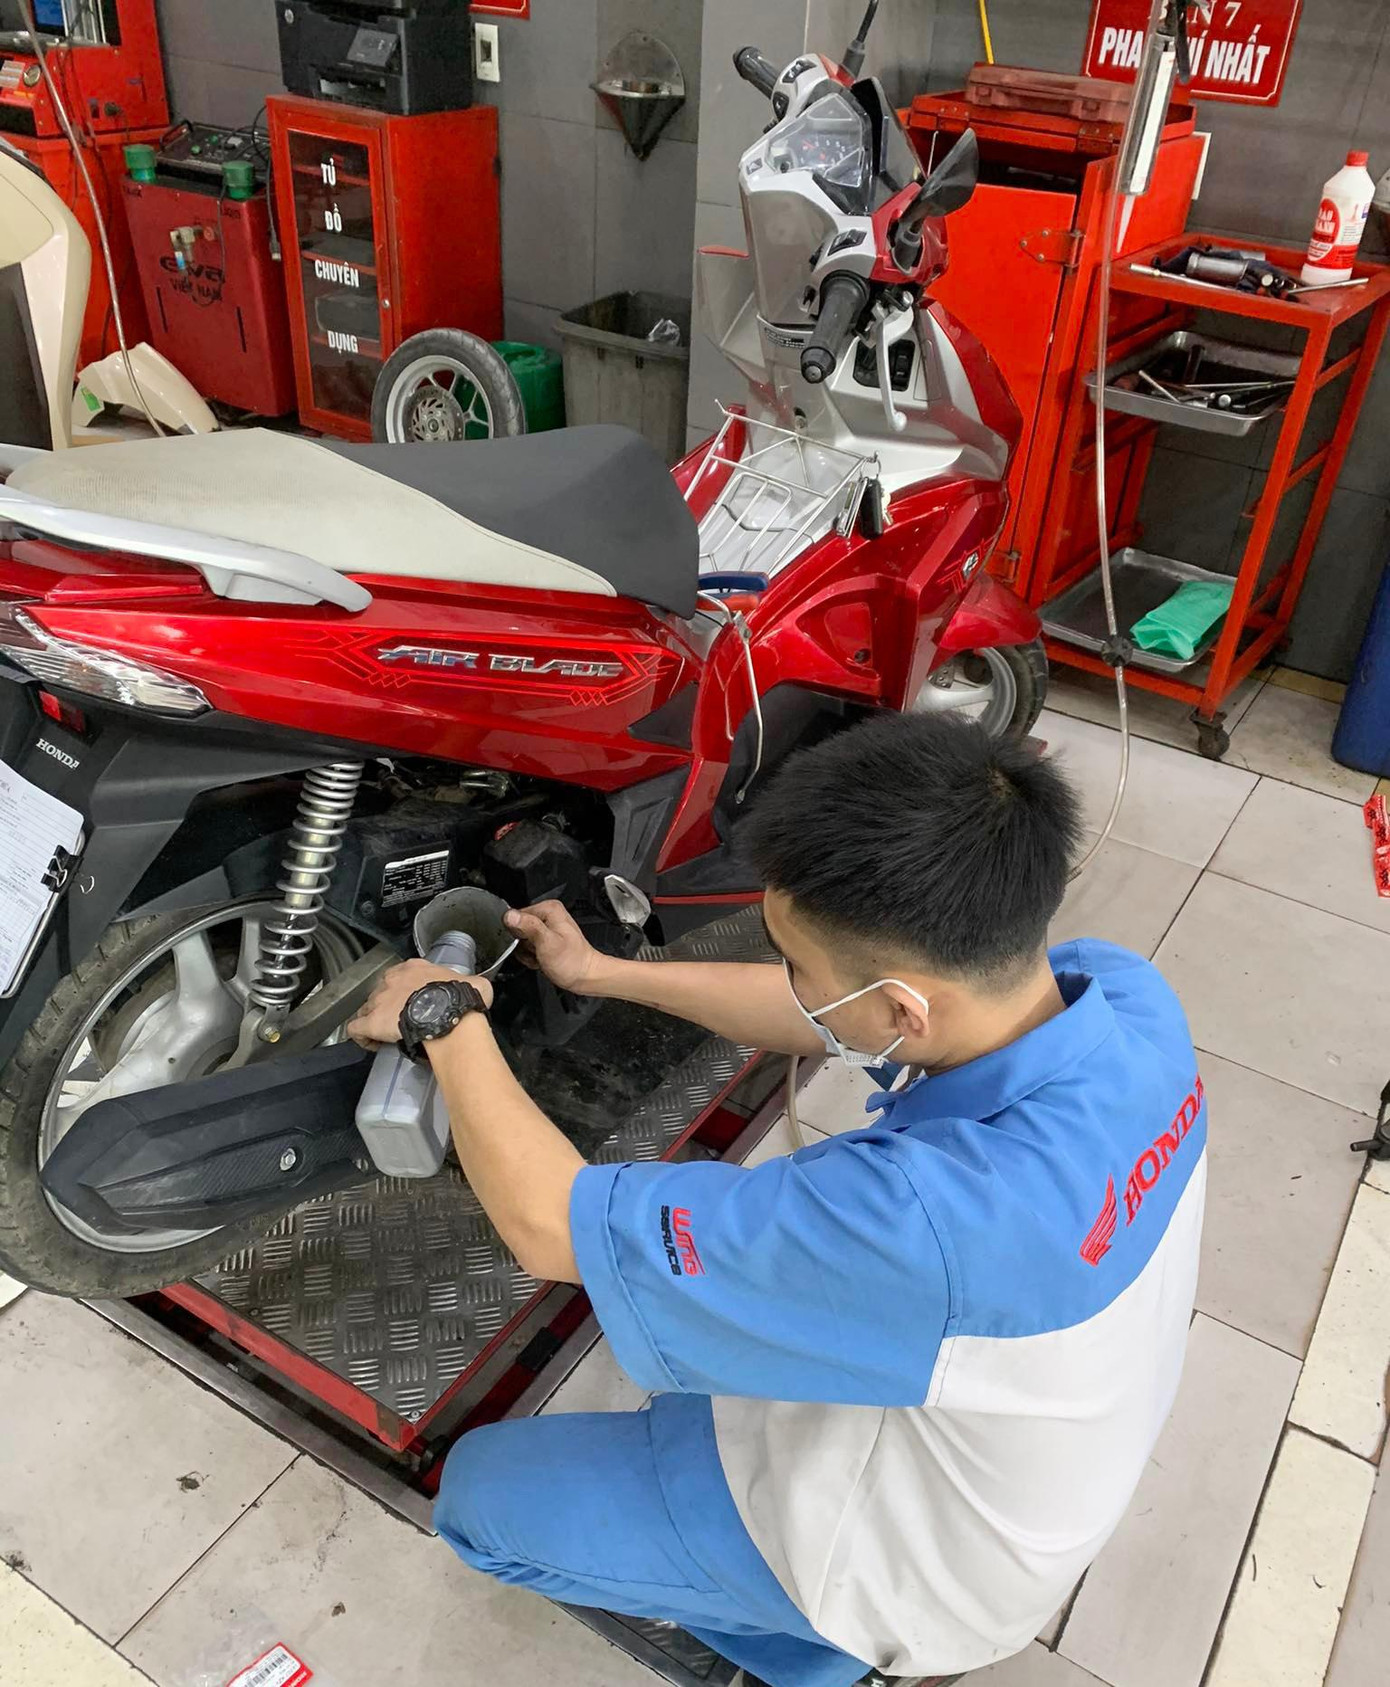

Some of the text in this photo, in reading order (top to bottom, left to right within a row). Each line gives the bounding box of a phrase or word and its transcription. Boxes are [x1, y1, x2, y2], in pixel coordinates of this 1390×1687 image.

[1224, 1, 1242, 29] 7
[1204, 23, 1272, 85] NHẤT
[320, 157, 337, 187] TỦ
[324, 202, 343, 233] ĐỒ
[314, 259, 360, 288] CHUYÊN
[327, 330, 359, 354] DỤNG
[377, 644, 624, 677] AIR BLADE
[35, 737, 81, 770] HONDA
[1123, 1073, 1204, 1227] HONDA
